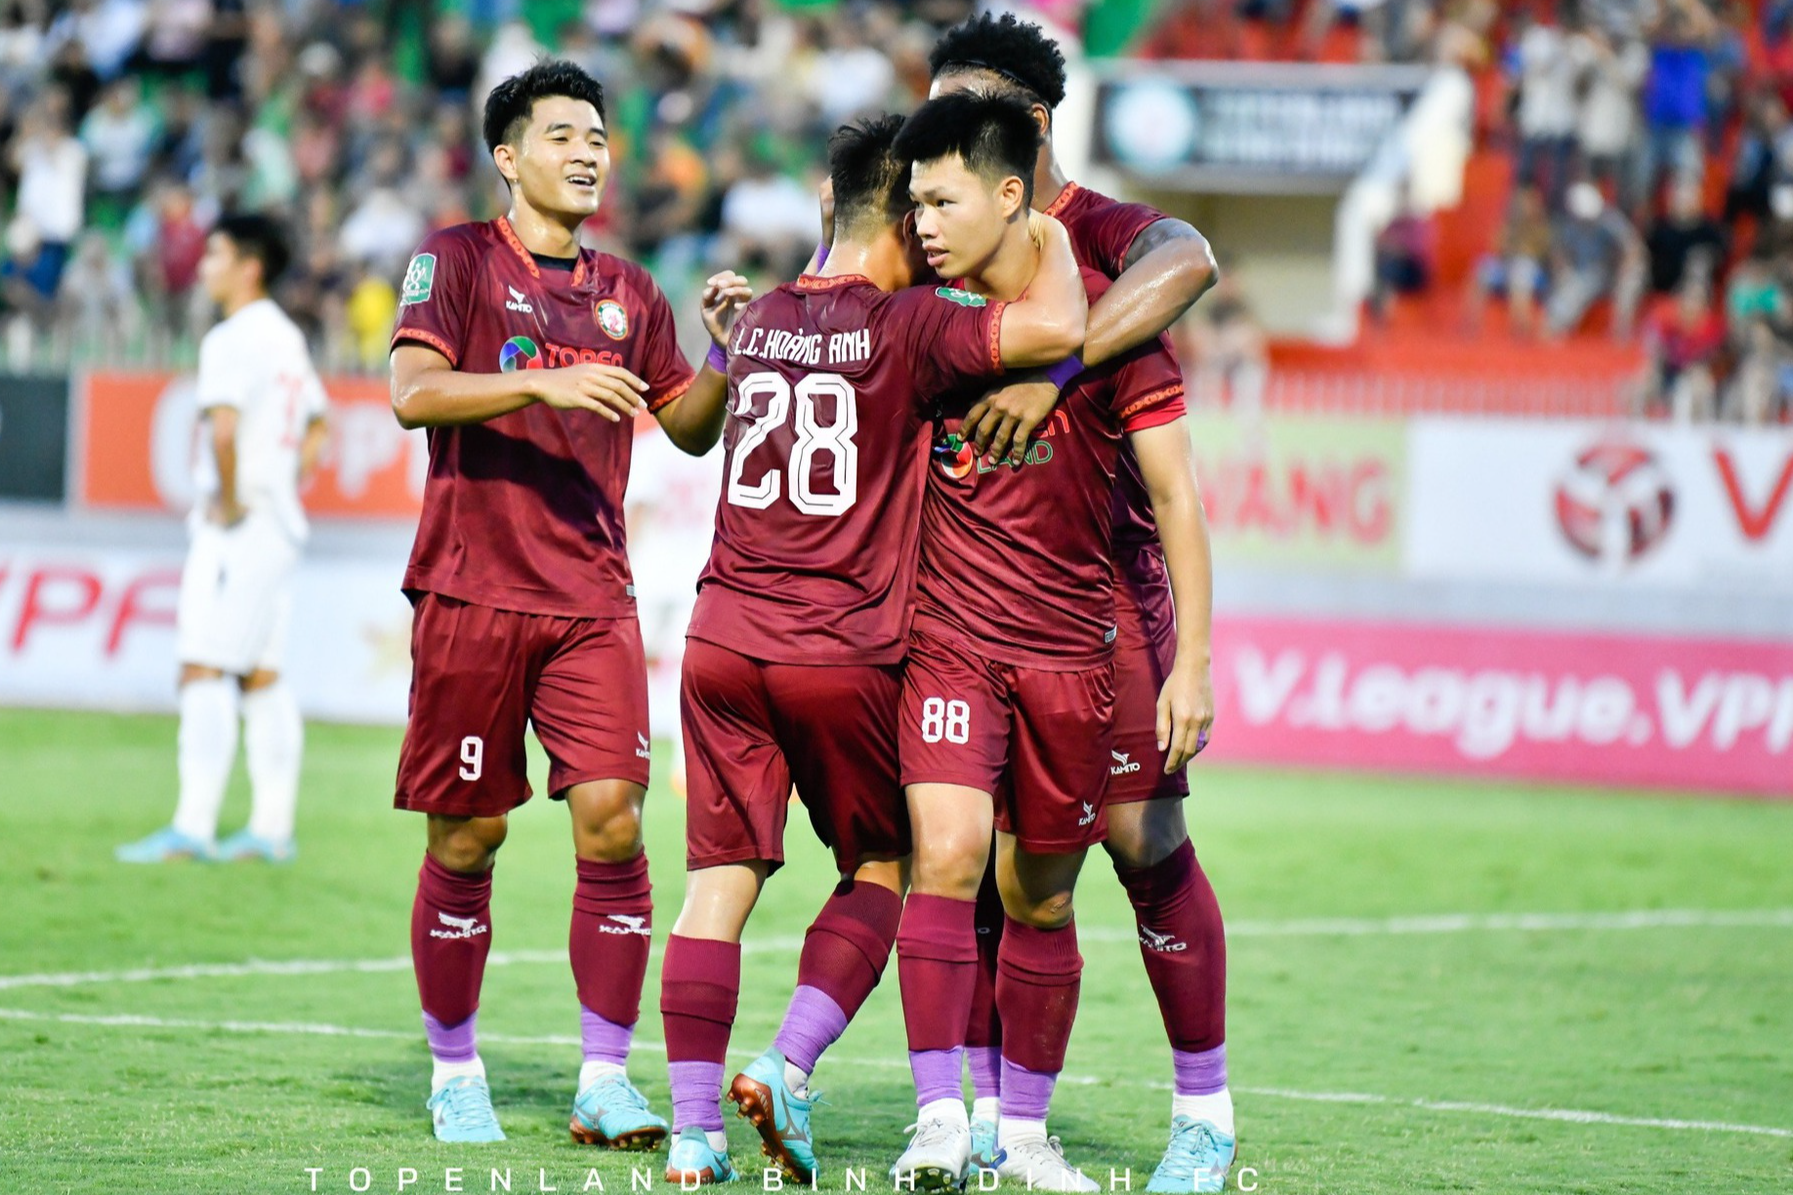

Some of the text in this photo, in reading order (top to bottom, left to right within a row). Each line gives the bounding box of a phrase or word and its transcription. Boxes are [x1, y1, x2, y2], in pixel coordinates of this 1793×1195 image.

[828, 328, 871, 364] ANH
[727, 371, 859, 517] 28
[921, 697, 971, 745] 88
[458, 735, 484, 782] 9
[1110, 763, 1142, 775] KAMITO
